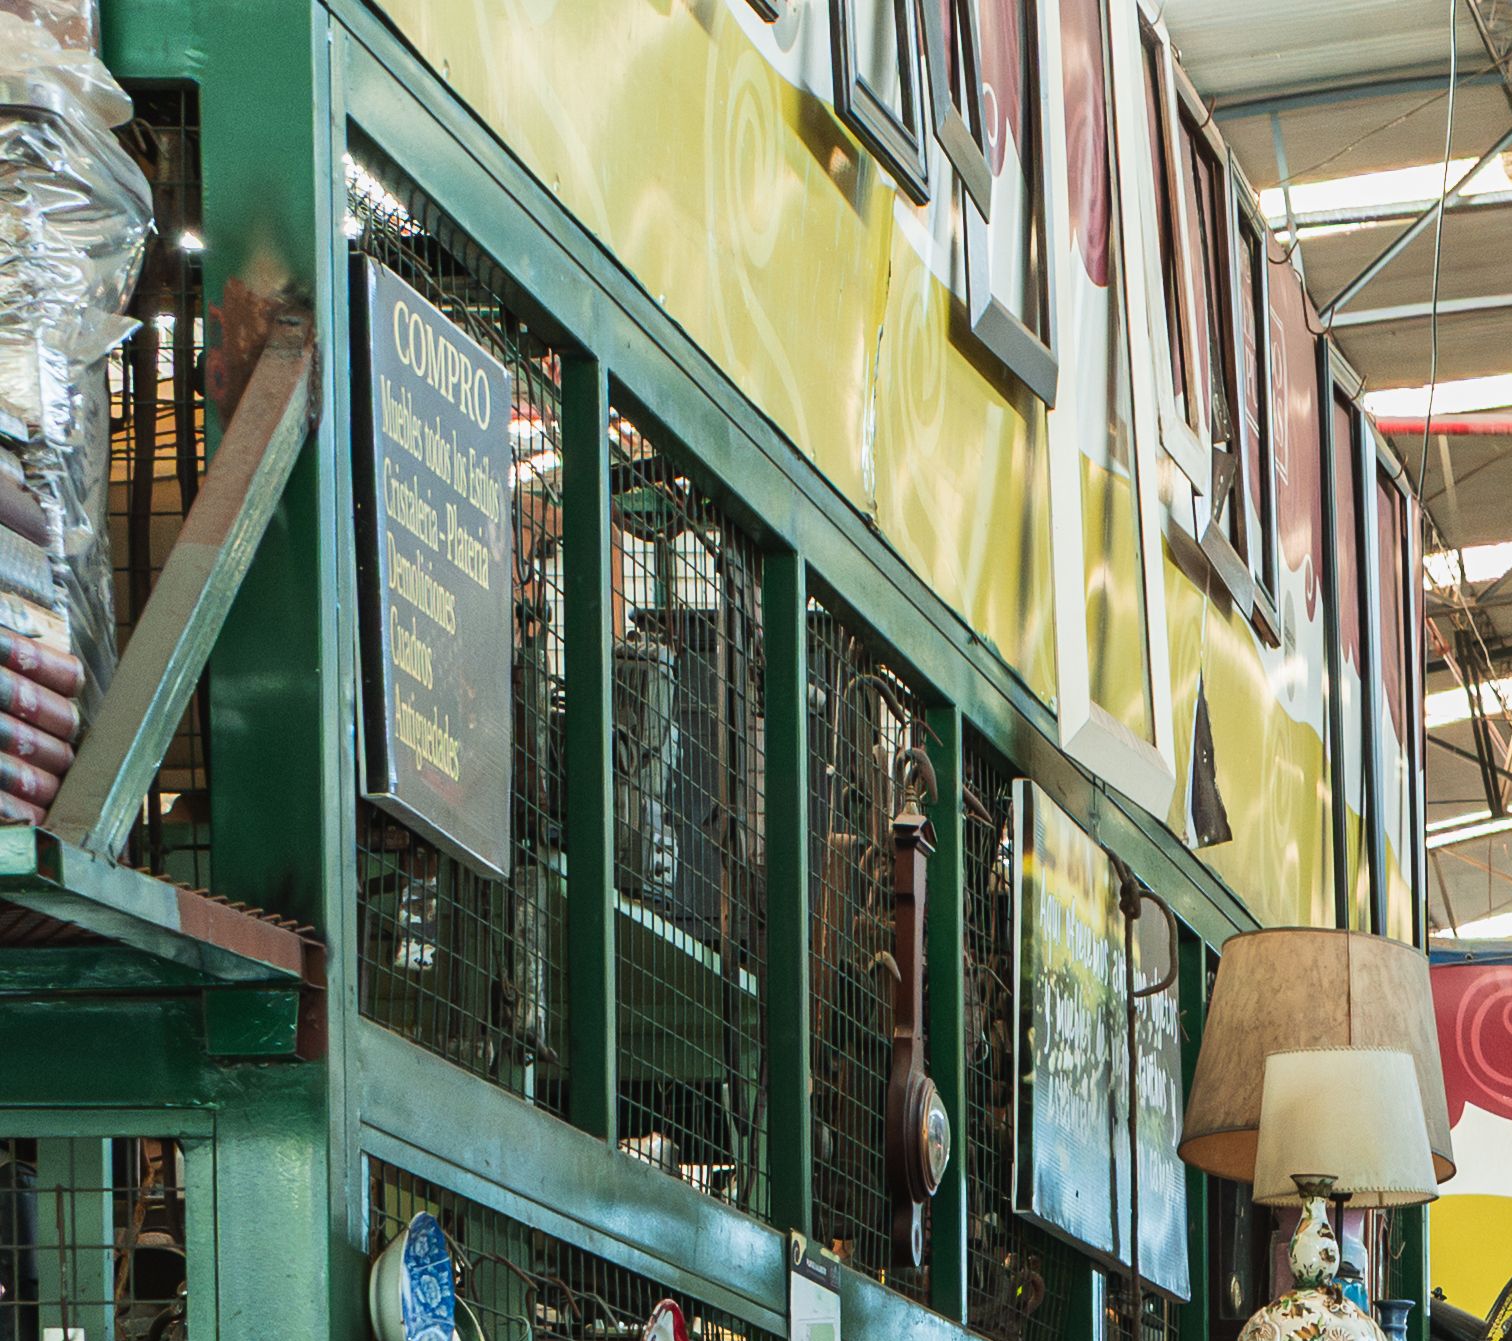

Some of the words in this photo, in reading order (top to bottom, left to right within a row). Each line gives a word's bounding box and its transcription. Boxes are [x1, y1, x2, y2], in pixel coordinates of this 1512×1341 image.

[393, 300, 491, 431] COMPRO
[381, 374, 423, 462] Muebles
[424, 416, 451, 485] todos
[452, 430, 467, 498] los
[469, 447, 500, 524] Estilos
[387, 530, 457, 636] Demoliciones
[390, 605, 433, 691] Cuadros
